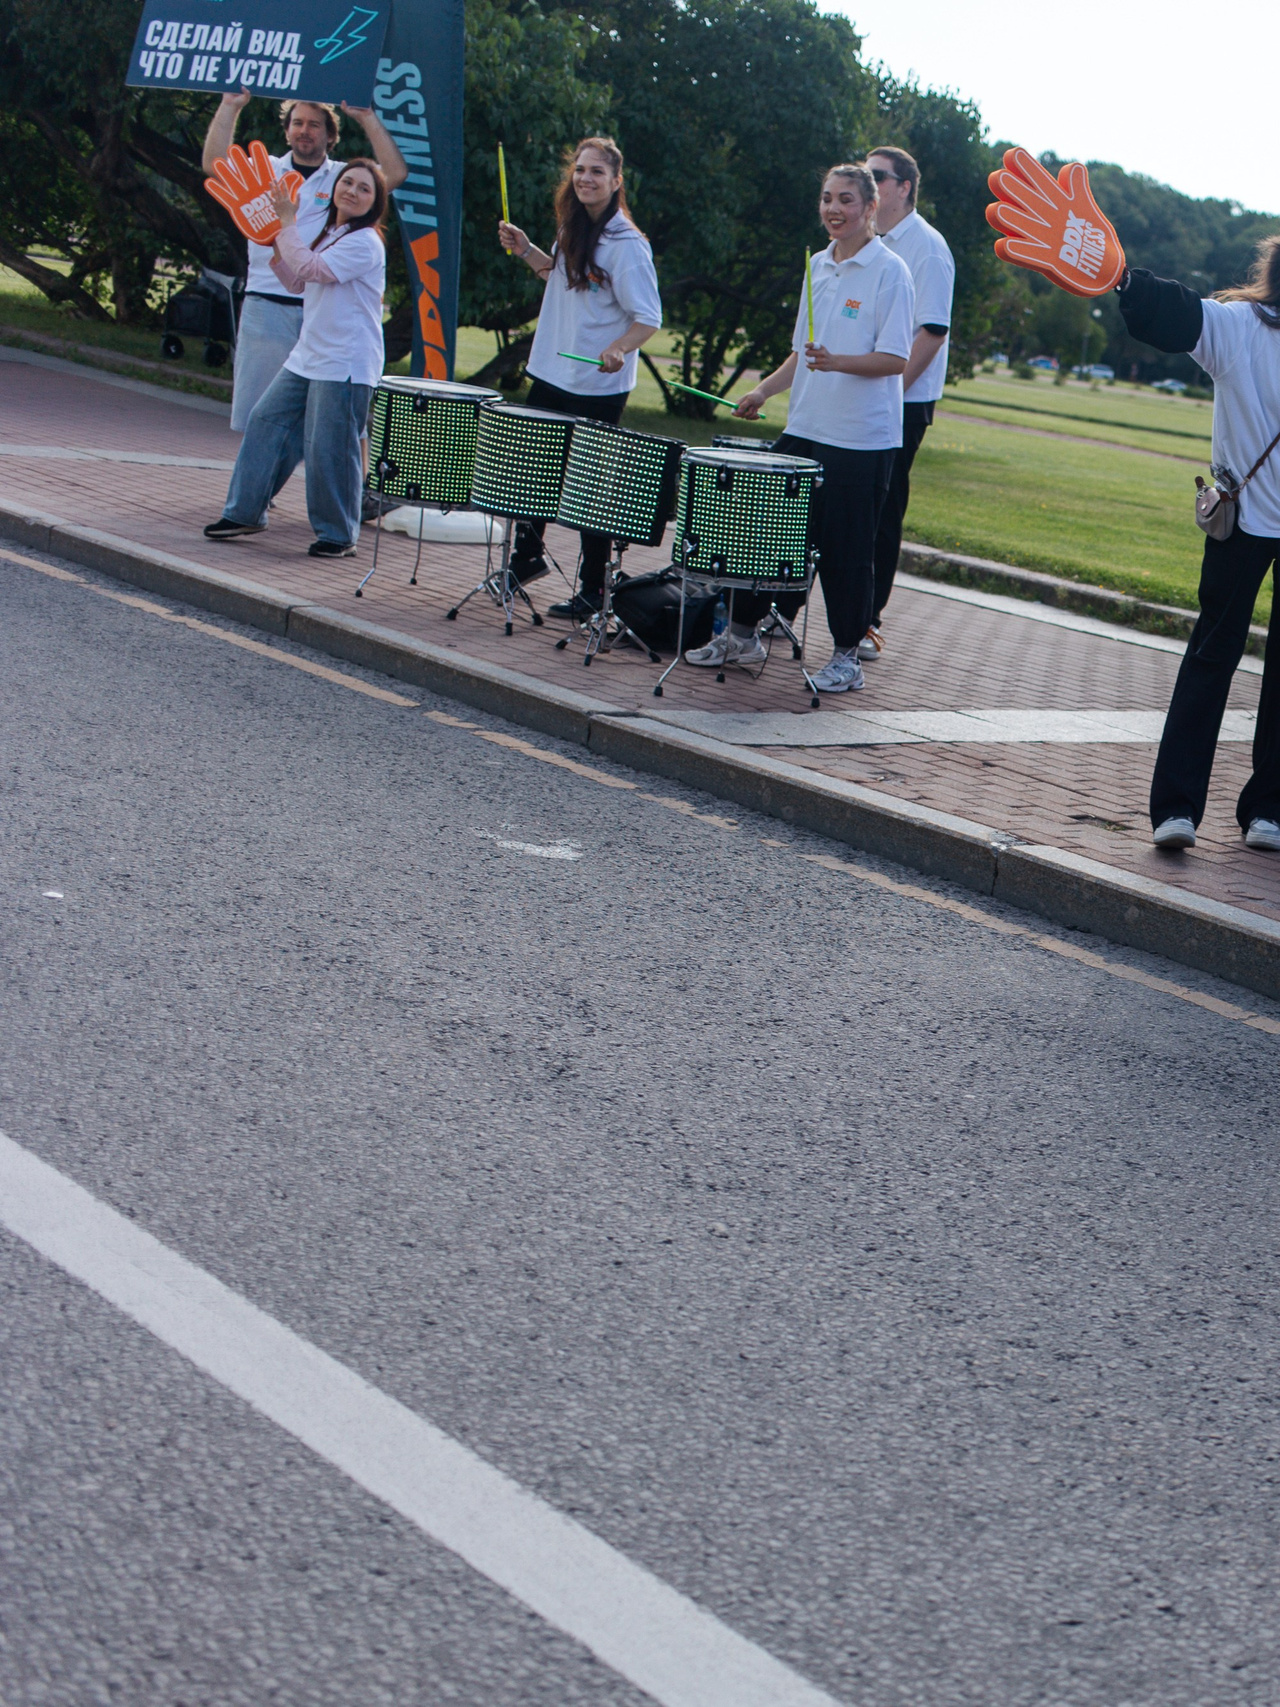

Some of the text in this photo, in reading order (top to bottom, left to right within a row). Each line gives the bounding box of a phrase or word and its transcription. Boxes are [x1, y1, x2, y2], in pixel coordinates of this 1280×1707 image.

[144, 20, 306, 64] СДЕЛАЙ ВИД,
[138, 50, 303, 91] ЧТО НЕ УСТАЛ
[247, 204, 280, 234] FITNES
[1059, 209, 1086, 268] DDX
[1076, 221, 1106, 280] FITNESS
